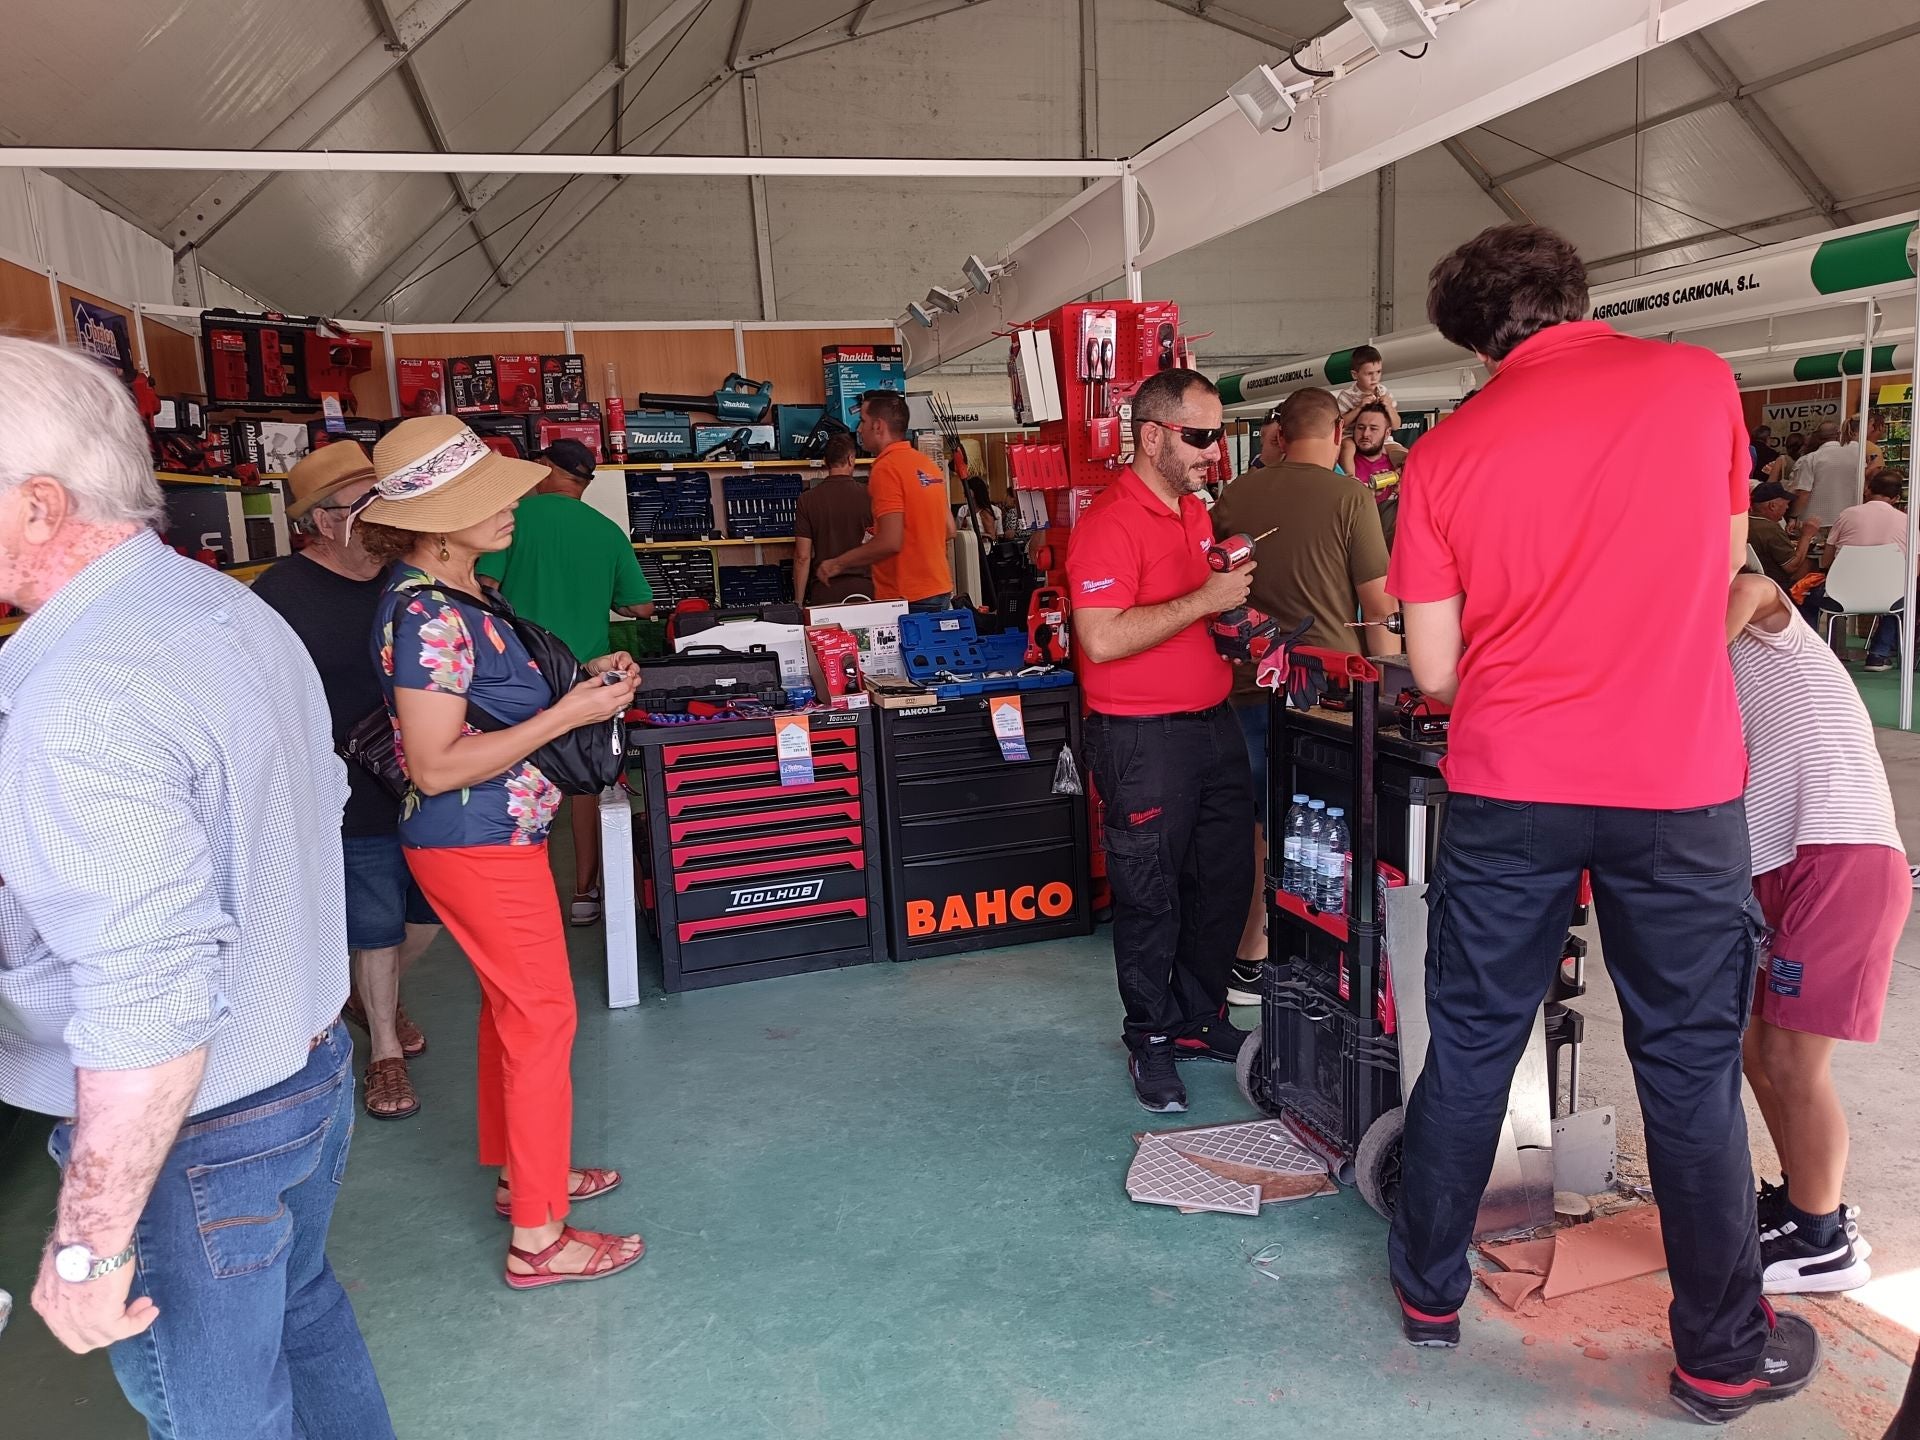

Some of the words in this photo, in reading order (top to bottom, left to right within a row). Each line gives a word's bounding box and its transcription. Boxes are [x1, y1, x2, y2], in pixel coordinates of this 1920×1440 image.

[1592, 292, 1670, 320] AGROQUIMICOS
[1672, 279, 1734, 304] CARMONA,
[1737, 274, 1760, 291] S.L.
[1768, 403, 1838, 420] VIVERO
[246, 423, 259, 463] WERKU
[899, 707, 929, 717] BAHCO
[730, 885, 813, 906] TOOLHUB
[906, 881, 1074, 937] BAHCO
